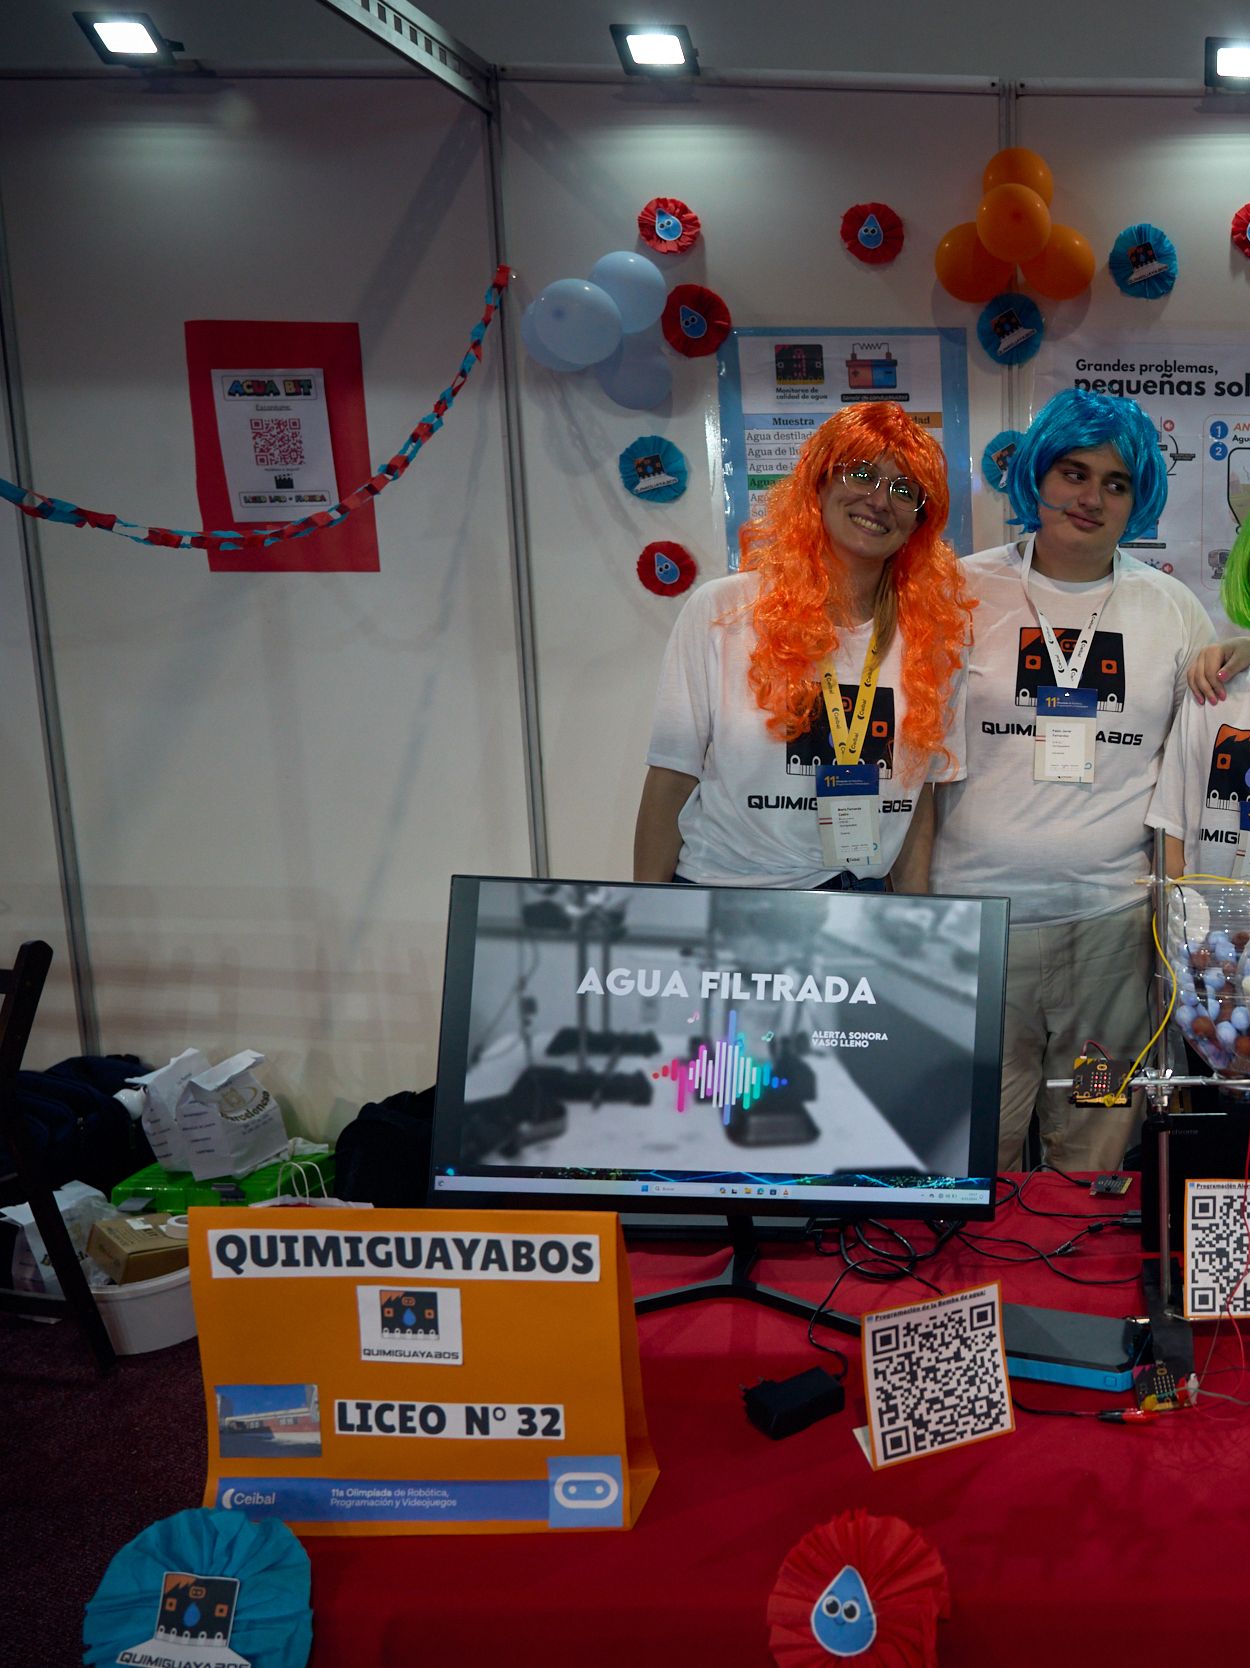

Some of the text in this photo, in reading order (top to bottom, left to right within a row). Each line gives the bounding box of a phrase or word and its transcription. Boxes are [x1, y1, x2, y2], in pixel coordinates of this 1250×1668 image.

[1076, 359, 1218, 375] Grandes problemas,
[1075, 373, 1206, 397] pequeñas
[772, 417, 815, 426] Muestra
[747, 431, 814, 442] Agua destilad
[748, 448, 773, 458] Agua
[775, 448, 787, 456] de
[749, 463, 773, 473] Agua
[776, 462, 788, 471] de
[982, 721, 1143, 746] QUIMIABOS
[748, 795, 912, 813] QUIMIGBOS
[576, 967, 876, 1005] AGUA FILTRADA
[812, 1030, 888, 1041] ALERTA SONORA
[812, 1038, 869, 1048] VASO LLENO
[215, 1234, 595, 1275] QUIMIGUAYABOS
[362, 1348, 460, 1360] QUIMIGUAYABOS
[337, 1402, 446, 1435] LICEO
[517, 1406, 562, 1437] 32
[234, 1492, 275, 1505] Ceibal
[346, 1488, 392, 1498] Olimpiada
[394, 1489, 405, 1497] de
[407, 1488, 448, 1498] Robótica,
[330, 1498, 457, 1509] Programación y Videojuegos
